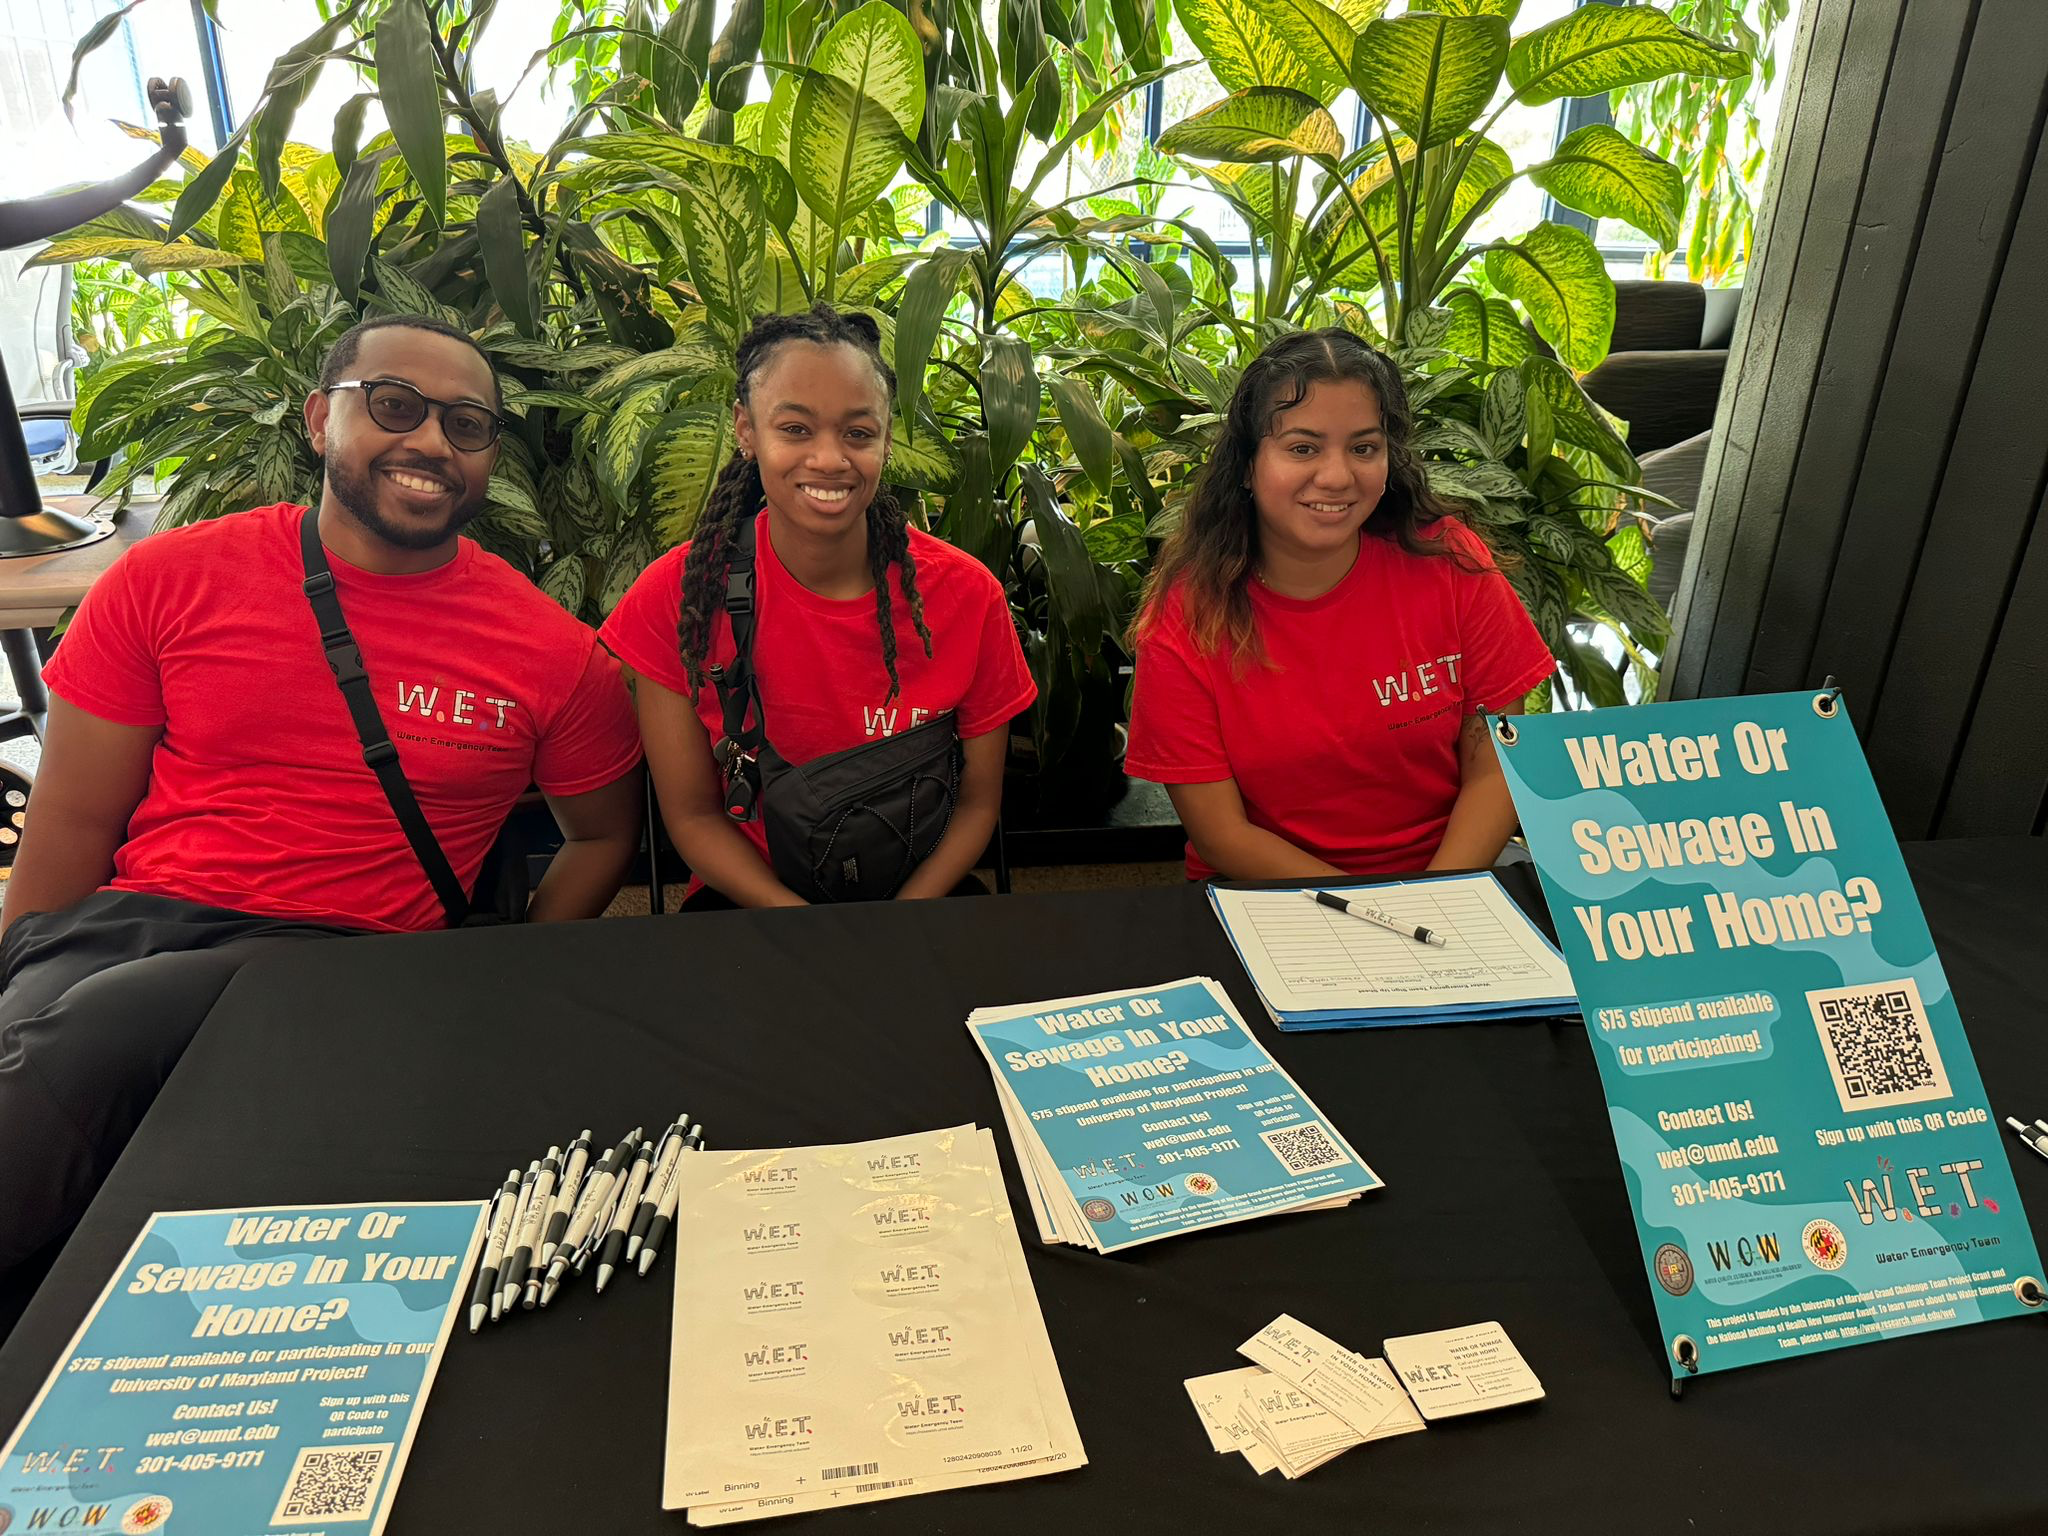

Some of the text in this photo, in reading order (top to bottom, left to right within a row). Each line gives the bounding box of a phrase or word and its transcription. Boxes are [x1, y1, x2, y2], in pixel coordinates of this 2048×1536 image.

[396, 730, 427, 743] Water
[430, 737, 485, 752] Emergency
[1563, 721, 1790, 790] Water Or
[1571, 800, 1838, 875] Sewage In
[1572, 876, 1882, 963] Your Home?
[1034, 997, 1164, 1035] Water Or
[1598, 992, 1774, 1033] $75 stipend available
[1004, 1013, 1231, 1072] Sewage In Your
[1618, 1030, 1763, 1067] for participating!
[1084, 1050, 1189, 1088] Home?
[1030, 1063, 1275, 1121] $75 stipend available for participating in our
[1076, 1083, 1249, 1127] University of Maryland Project!
[1141, 1111, 1213, 1133] Contact Us!
[1657, 1099, 1755, 1132] Contact Us!
[1814, 1106, 1988, 1148] Sign up with this QR Code
[1143, 1123, 1233, 1151] wet@umd.edu
[1155, 1138, 1241, 1166] 301-405-9171
[1656, 1134, 1779, 1170] wet@umd.edu
[1670, 1170, 1786, 1207] 301-405-9171
[224, 1211, 407, 1247] Water Or
[1876, 1236, 2001, 1265] Water Emergency Team
[127, 1252, 457, 1295] Sewage In Your
[1706, 1267, 2006, 1329] This project is funded by the University of Maryland Grand Challenge Team Project Grant and
[190, 1297, 350, 1338] Home?
[1706, 1335, 1719, 1345] the
[1718, 1329, 1748, 1344] National
[1747, 1325, 1776, 1339] Institute
[1777, 1322, 1785, 1332] of
[1784, 1319, 1808, 1331] Health
[1808, 1317, 1822, 1327] New
[1822, 1310, 1856, 1325] Innovator
[1878, 1304, 1887, 1313] To
[1887, 1301, 1906, 1312] learn
[1906, 1299, 1925, 1309] more
[1926, 1294, 1946, 1306] about
[1946, 1291, 1958, 1302] the
[1958, 1287, 1979, 1300] Water
[1777, 1338, 1801, 1349] Team,
[1800, 1331, 1823, 1345] please
[68, 1341, 434, 1374] $75 stipend available for participating in our
[1336, 1349, 1358, 1365] WATER
[1358, 1364, 1369, 1372] OR
[1370, 1371, 1396, 1391] SEWAGE
[109, 1364, 368, 1394] University of Maryland Project!
[1340, 1360, 1358, 1374] YOUR
[1358, 1373, 1382, 1390] HOME?
[172, 1399, 279, 1421] Contact Us!
[319, 1392, 410, 1409] Sign up with this
[329, 1408, 389, 1422] QR Code to
[144, 1423, 281, 1448] wet@umd.edu
[322, 1424, 383, 1439] participate
[135, 1450, 266, 1474] 301-405-9171
[943, 1444, 1033, 1463] 12802420908035 11/20
[724, 1481, 760, 1493] Binning
[758, 1496, 794, 1508] Binning
